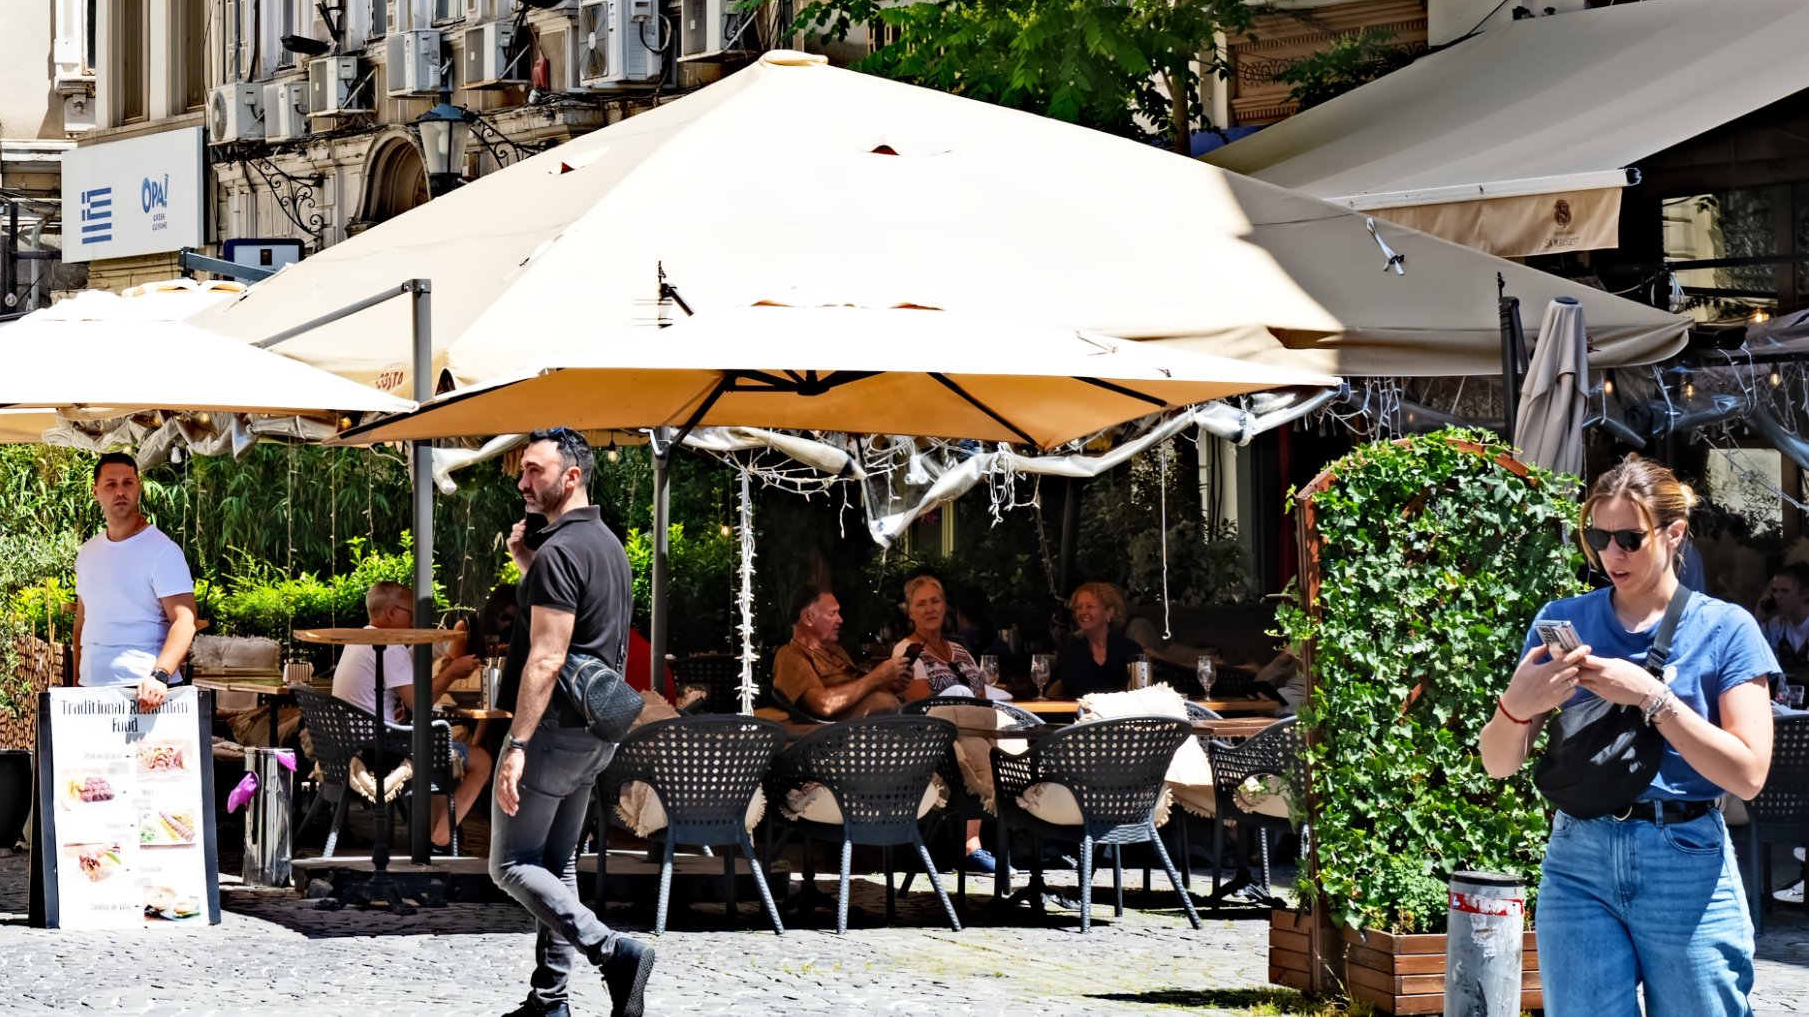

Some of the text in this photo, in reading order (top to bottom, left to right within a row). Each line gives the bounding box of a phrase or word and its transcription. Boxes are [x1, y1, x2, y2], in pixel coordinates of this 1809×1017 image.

[142, 173, 169, 214] OPA!
[61, 700, 125, 715] Traditional
[112, 718, 139, 733] Food
